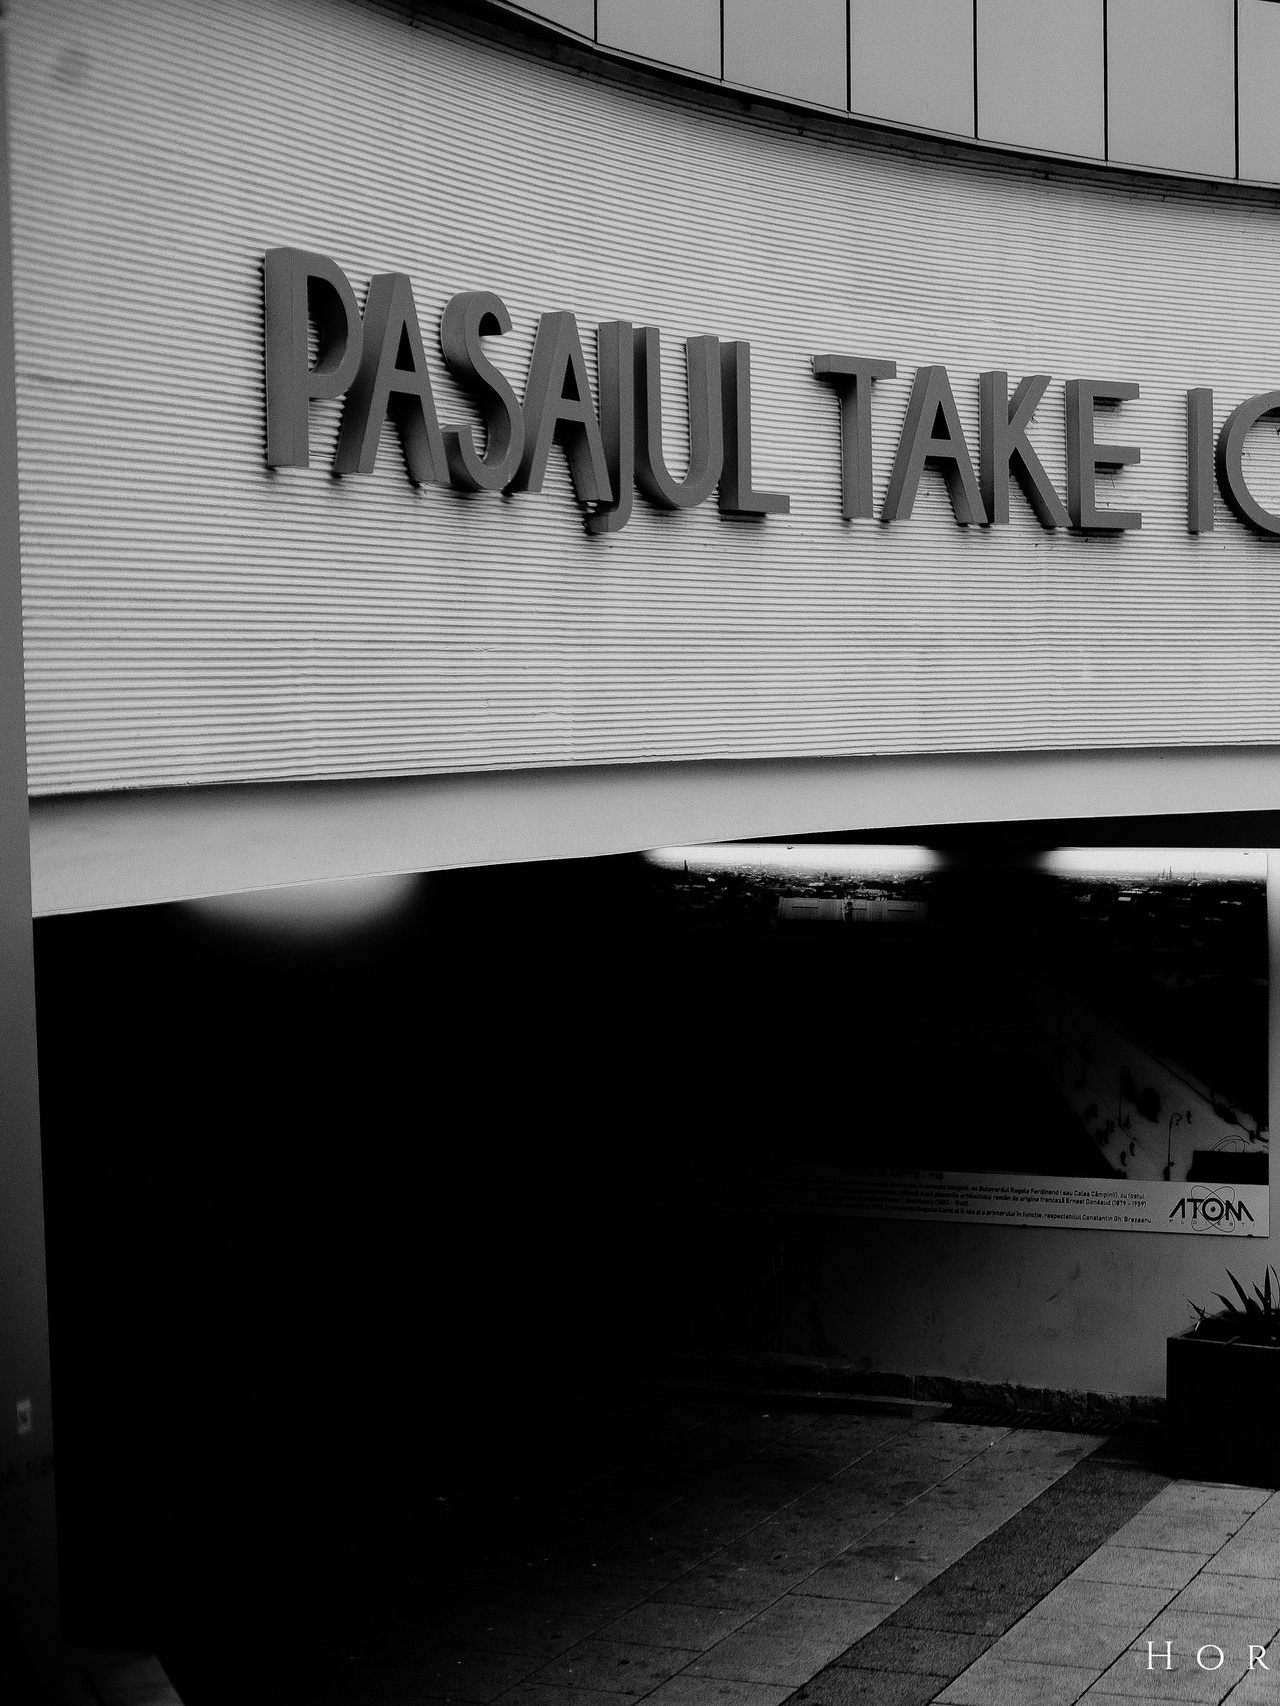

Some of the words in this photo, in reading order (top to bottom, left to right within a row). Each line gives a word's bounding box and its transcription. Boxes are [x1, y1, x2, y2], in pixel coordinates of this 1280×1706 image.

[265, 246, 791, 533] PASAJUL
[812, 353, 1142, 533] TAKE
[1019, 1195, 1039, 1203] origine
